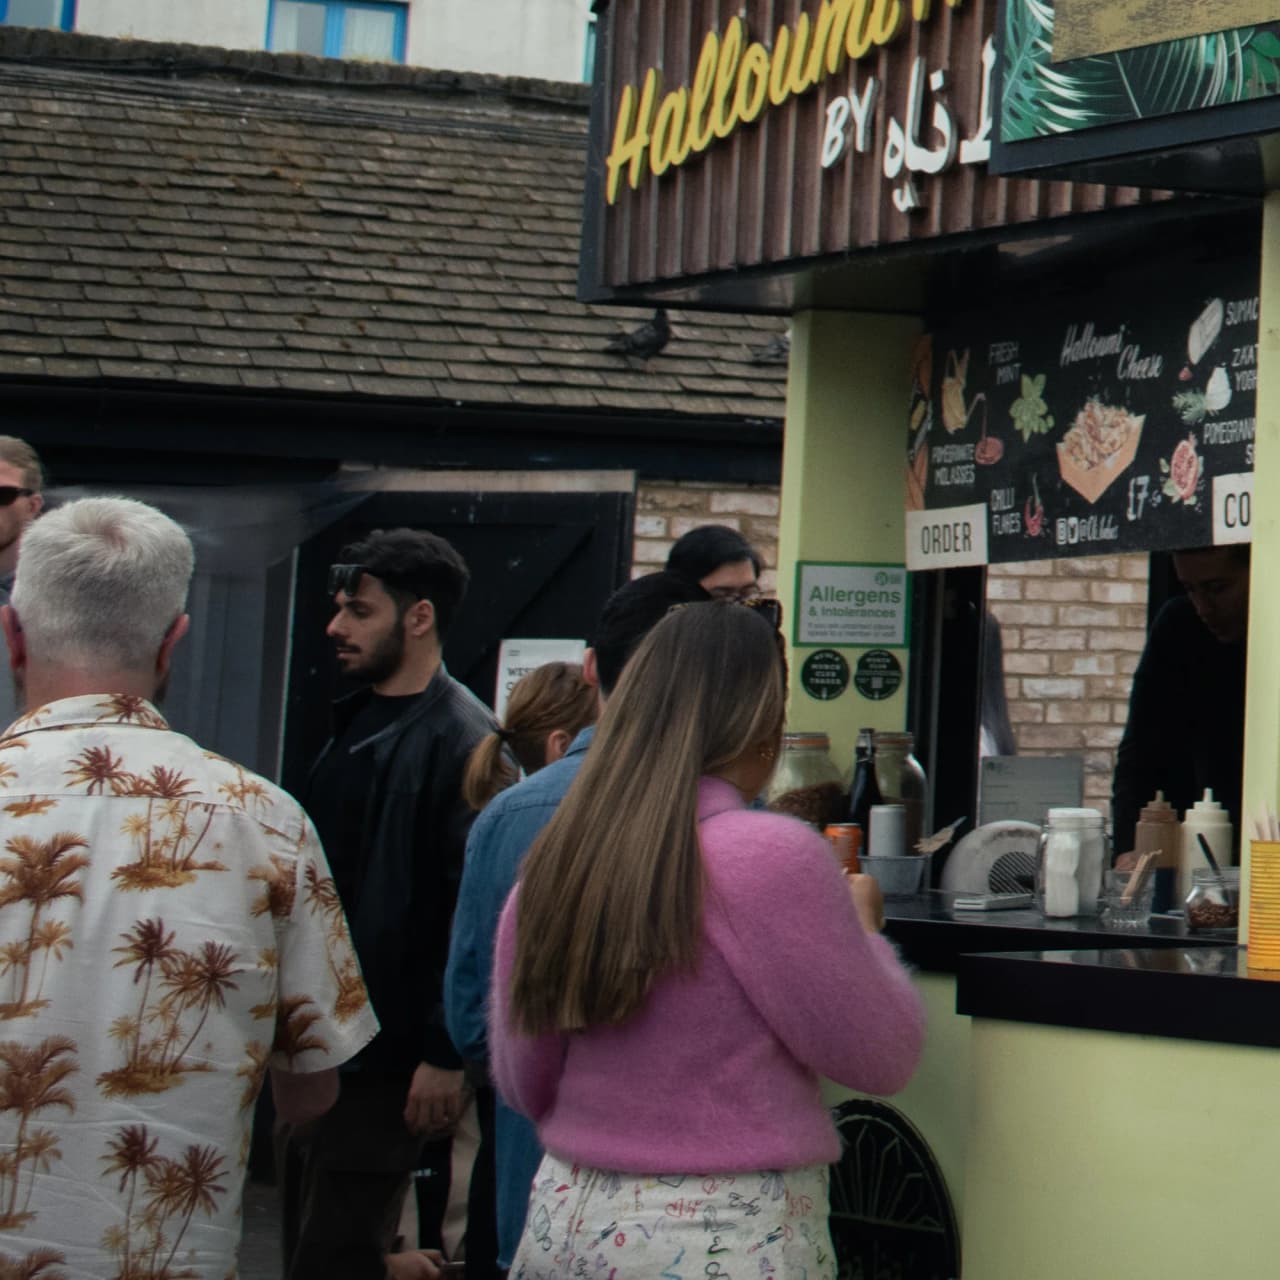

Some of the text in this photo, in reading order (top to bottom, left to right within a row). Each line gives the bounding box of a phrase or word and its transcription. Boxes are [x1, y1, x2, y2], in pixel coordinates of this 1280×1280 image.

[821, 77, 875, 169] BY
[1060, 322, 1163, 381] Halloumi Cheese
[921, 522, 972, 555] ORDER
[809, 585, 901, 606] Allergens
[822, 606, 897, 618] Intolerances
